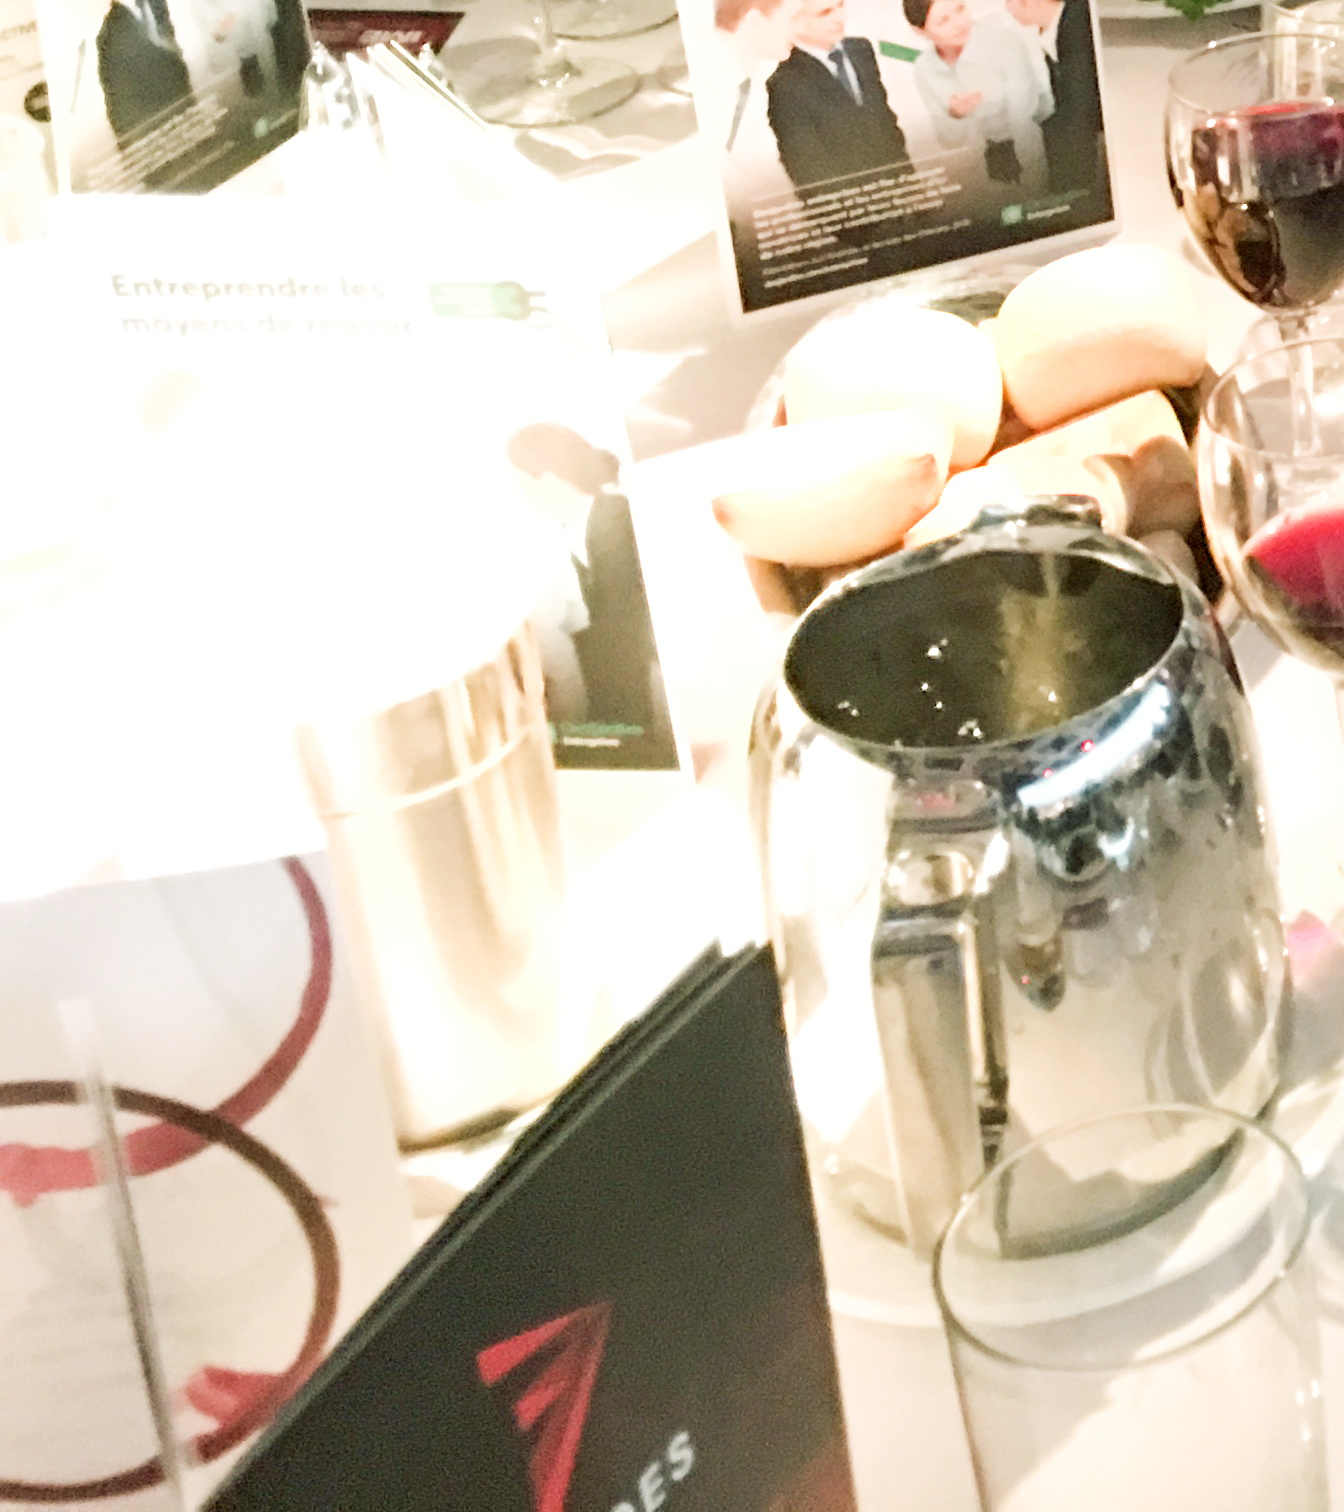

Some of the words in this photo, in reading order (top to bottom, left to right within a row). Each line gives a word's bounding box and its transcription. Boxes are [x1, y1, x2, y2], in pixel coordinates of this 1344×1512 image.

[111, 274, 329, 302] Entreprendre
[340, 275, 386, 298] les
[122, 317, 247, 338] moyens
[257, 313, 297, 333] de
